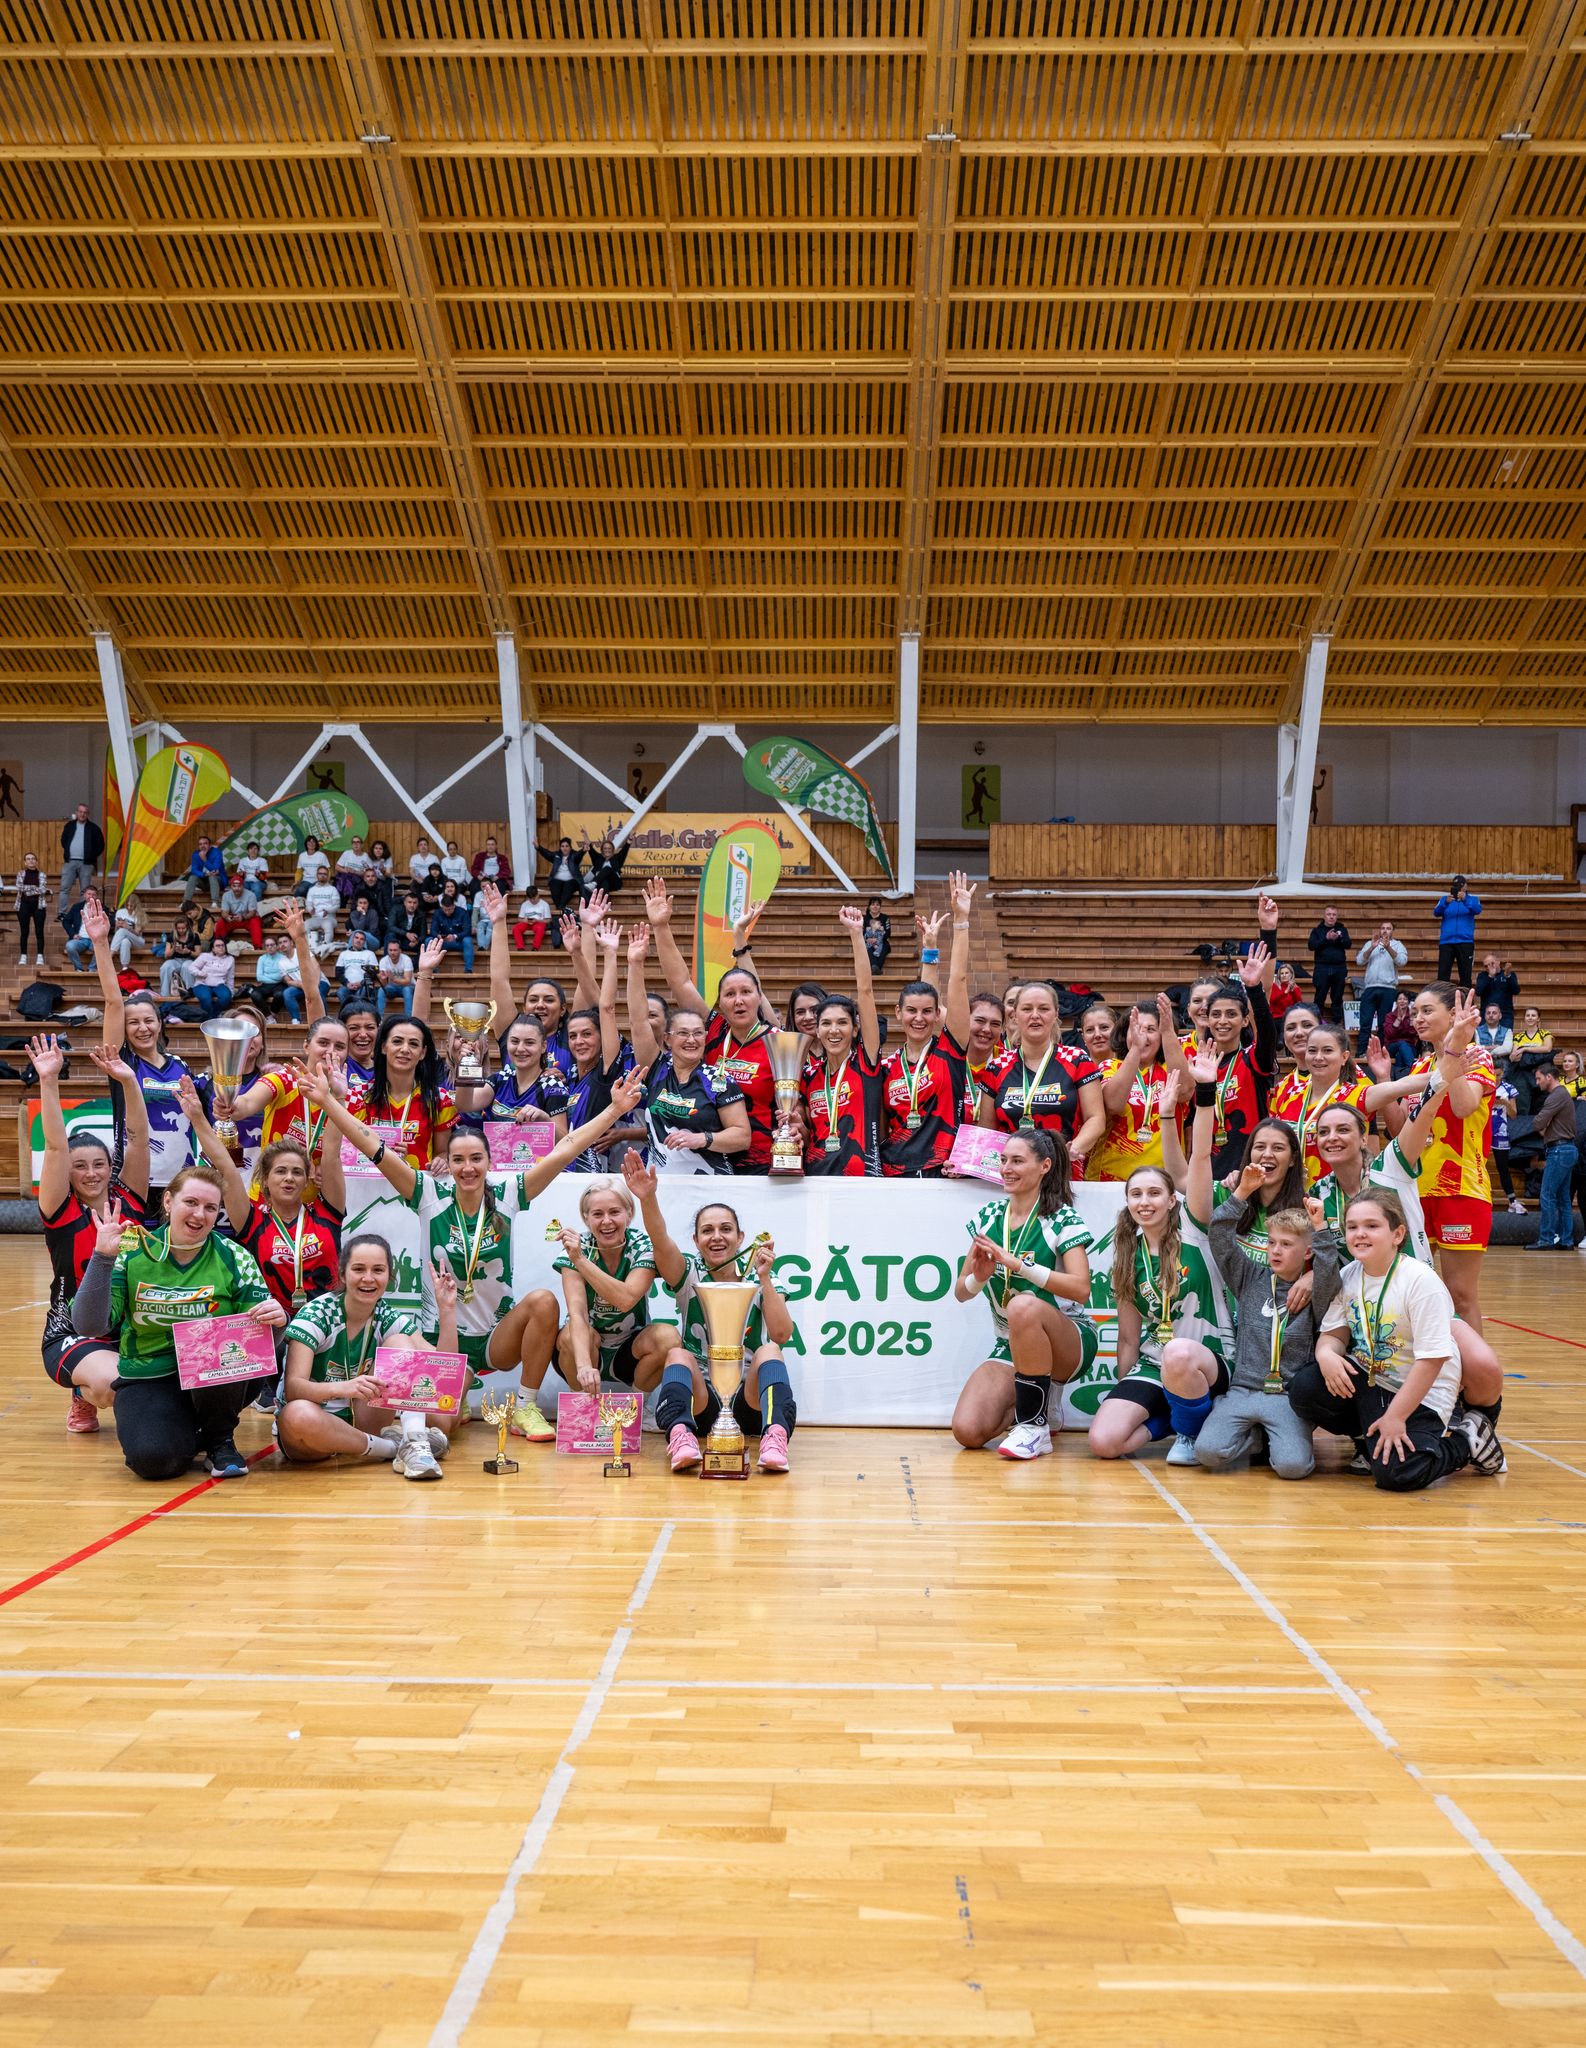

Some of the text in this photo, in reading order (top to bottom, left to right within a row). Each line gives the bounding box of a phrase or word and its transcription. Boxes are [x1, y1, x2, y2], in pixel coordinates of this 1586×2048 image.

[173, 773, 189, 816] CATENA
[643, 850, 685, 861] Resort
[734, 1072, 751, 1080] TEAM
[889, 1086, 910, 1098] RACIN
[1064, 1235, 1091, 1249] RACING
[302, 1246, 317, 1258] EAM
[1252, 1252, 1268, 1264] TEA
[771, 1245, 966, 1302] GĂTO
[146, 1289, 194, 1300] CATENA
[136, 1303, 206, 1316] RACING TEAM
[820, 1321, 933, 1356] 2025
